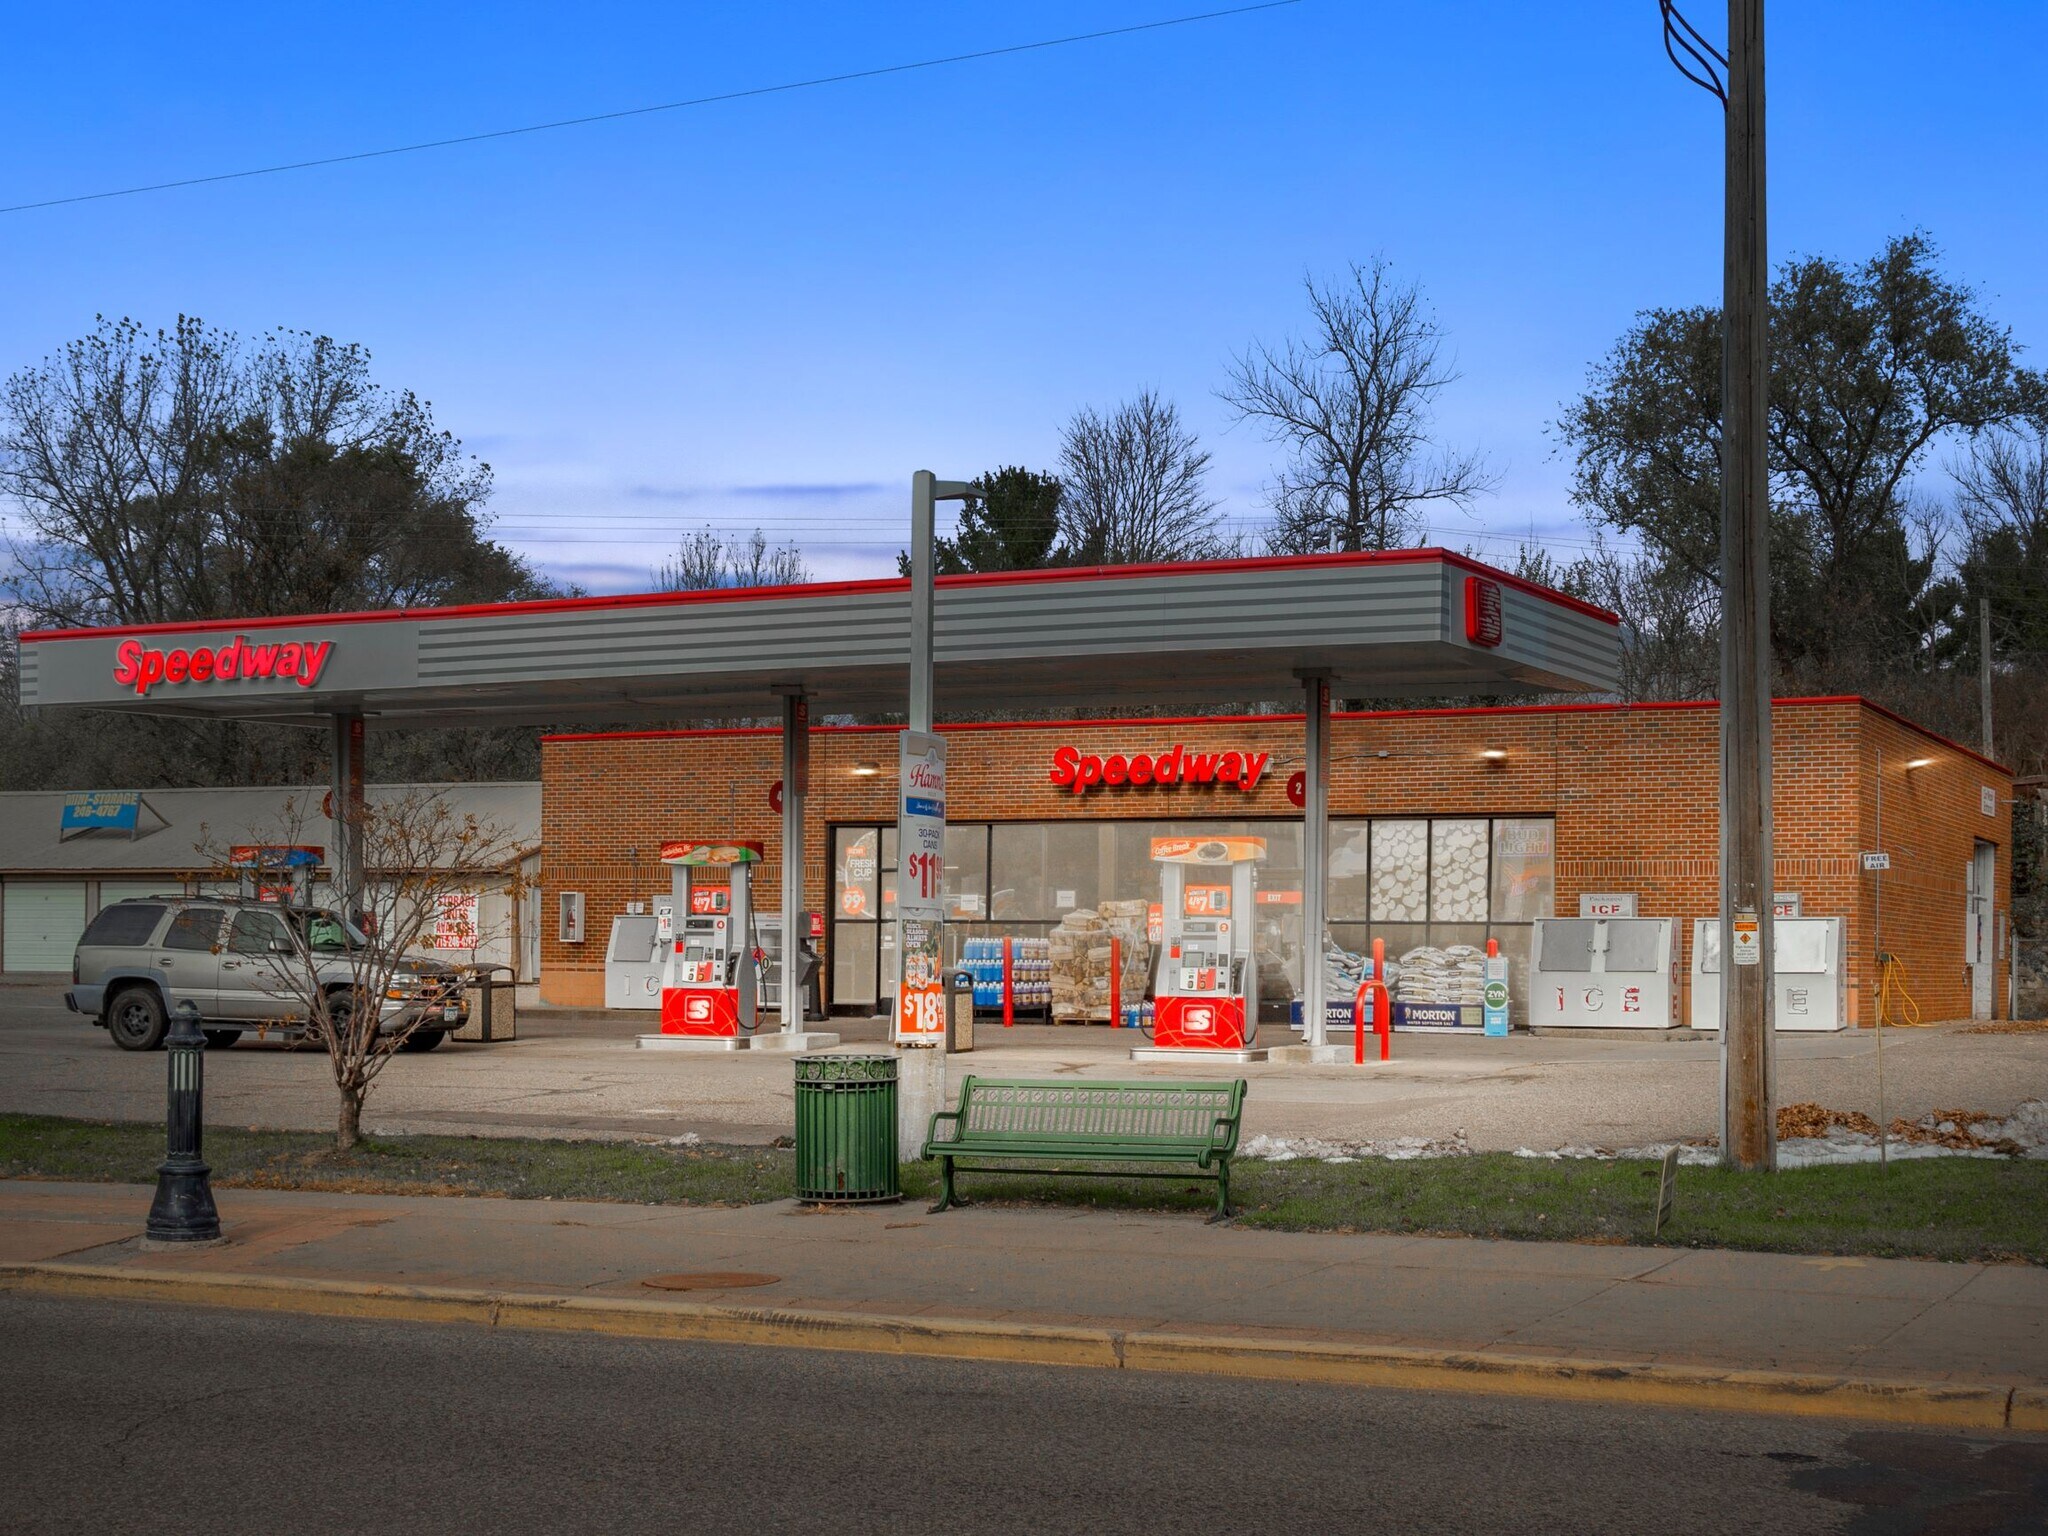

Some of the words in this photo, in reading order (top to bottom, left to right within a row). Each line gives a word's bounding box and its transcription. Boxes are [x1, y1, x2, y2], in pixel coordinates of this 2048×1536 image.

[114, 635, 330, 694] Speedway
[1050, 744, 1269, 794] Speedway
[1296, 783, 1302, 794] 2
[918, 828, 940, 839] 30-PACK
[1507, 828, 1540, 841] BUD
[923, 840, 938, 849] CANS
[1154, 844, 1171, 855] Coffee
[1173, 842, 1190, 852] Break
[1501, 841, 1546, 854] LIGHT
[849, 859, 876, 868] FRESH
[853, 868, 872, 877] CUP
[437, 895, 476, 907] STORAGE
[1267, 894, 1281, 902] EXIT
[443, 909, 468, 920] UNITS
[1774, 905, 1793, 915] CE
[1220, 923, 1228, 931] 2
[624, 975, 660, 997] IC
[1488, 990, 1505, 998] ZYN
[1556, 986, 1640, 1012] ICE
[687, 1000, 710, 1019] S
[1326, 1008, 1351, 1019] RTON
[1184, 1009, 1212, 1031] S
[1412, 1010, 1456, 1021] MORTON
